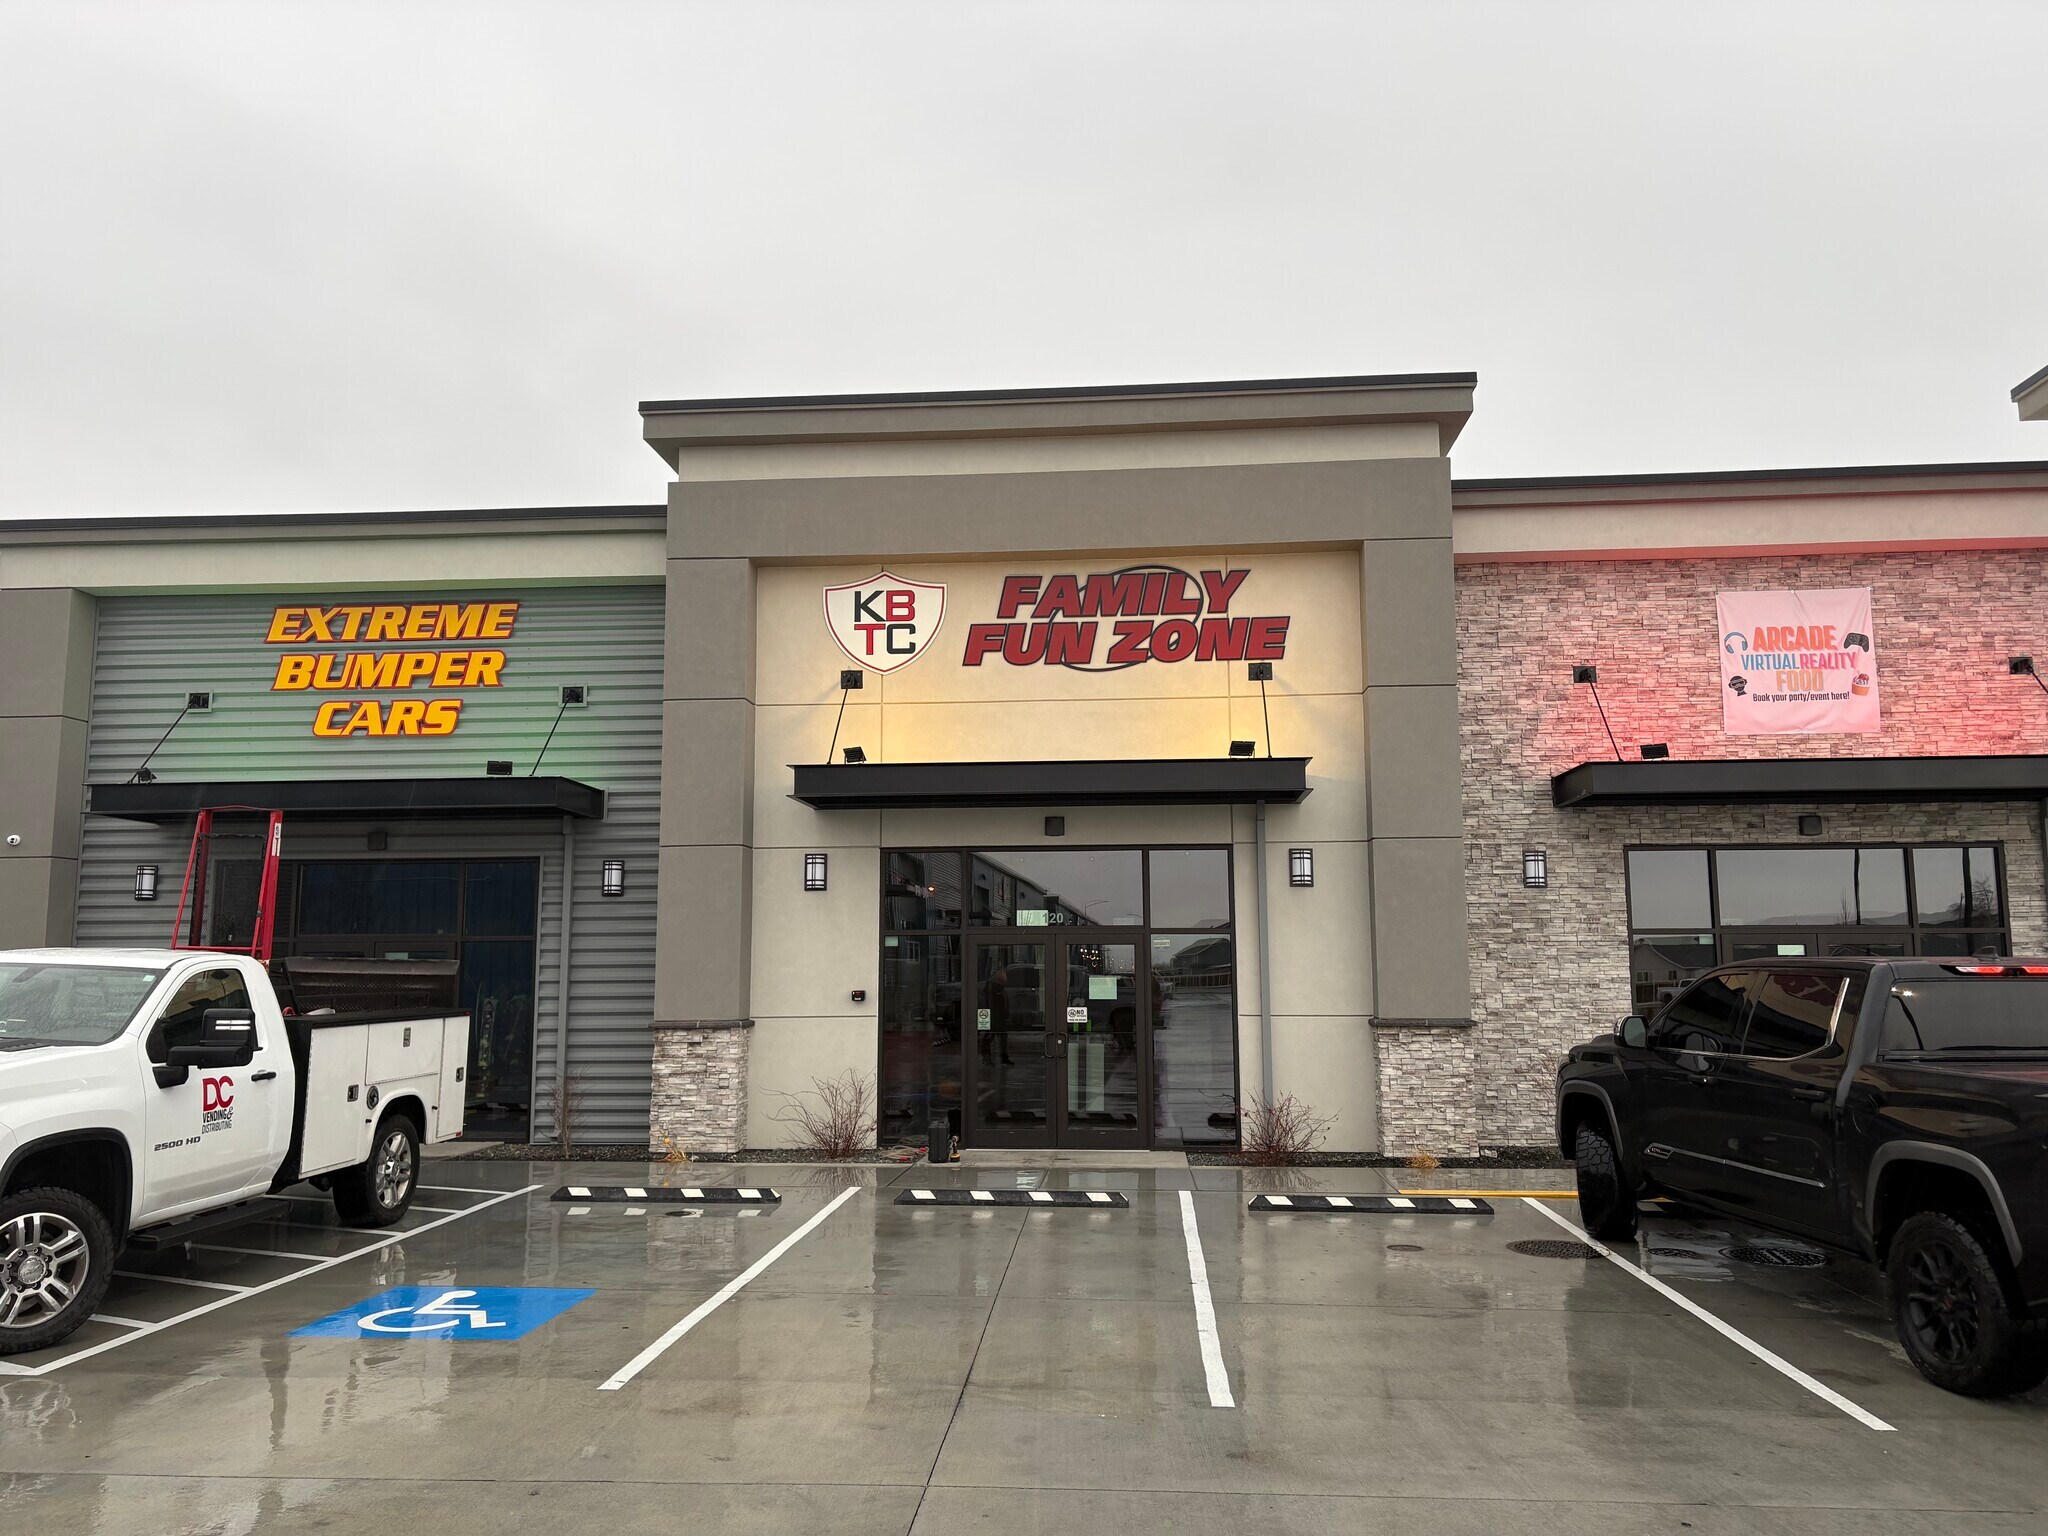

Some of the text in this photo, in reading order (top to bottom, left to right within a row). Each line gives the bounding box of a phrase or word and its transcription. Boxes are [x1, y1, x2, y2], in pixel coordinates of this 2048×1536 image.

[996, 569, 1251, 619] FAMILY
[264, 602, 520, 644] EXTREME
[1752, 625, 1839, 651] ARCADE
[962, 615, 1291, 666] FUN ZONE
[270, 650, 506, 691] BUMPER
[1776, 670, 1825, 692] FOOD
[1753, 693, 1770, 701] Book
[1771, 694, 1787, 702] your
[1831, 691, 1850, 700] here!
[312, 699, 463, 736] CARS
[1043, 912, 1064, 923] 120
[202, 1075, 234, 1112] DC
[201, 1119, 232, 1134] DISTRIBUTING
[154, 1135, 201, 1151] 2500 HD
